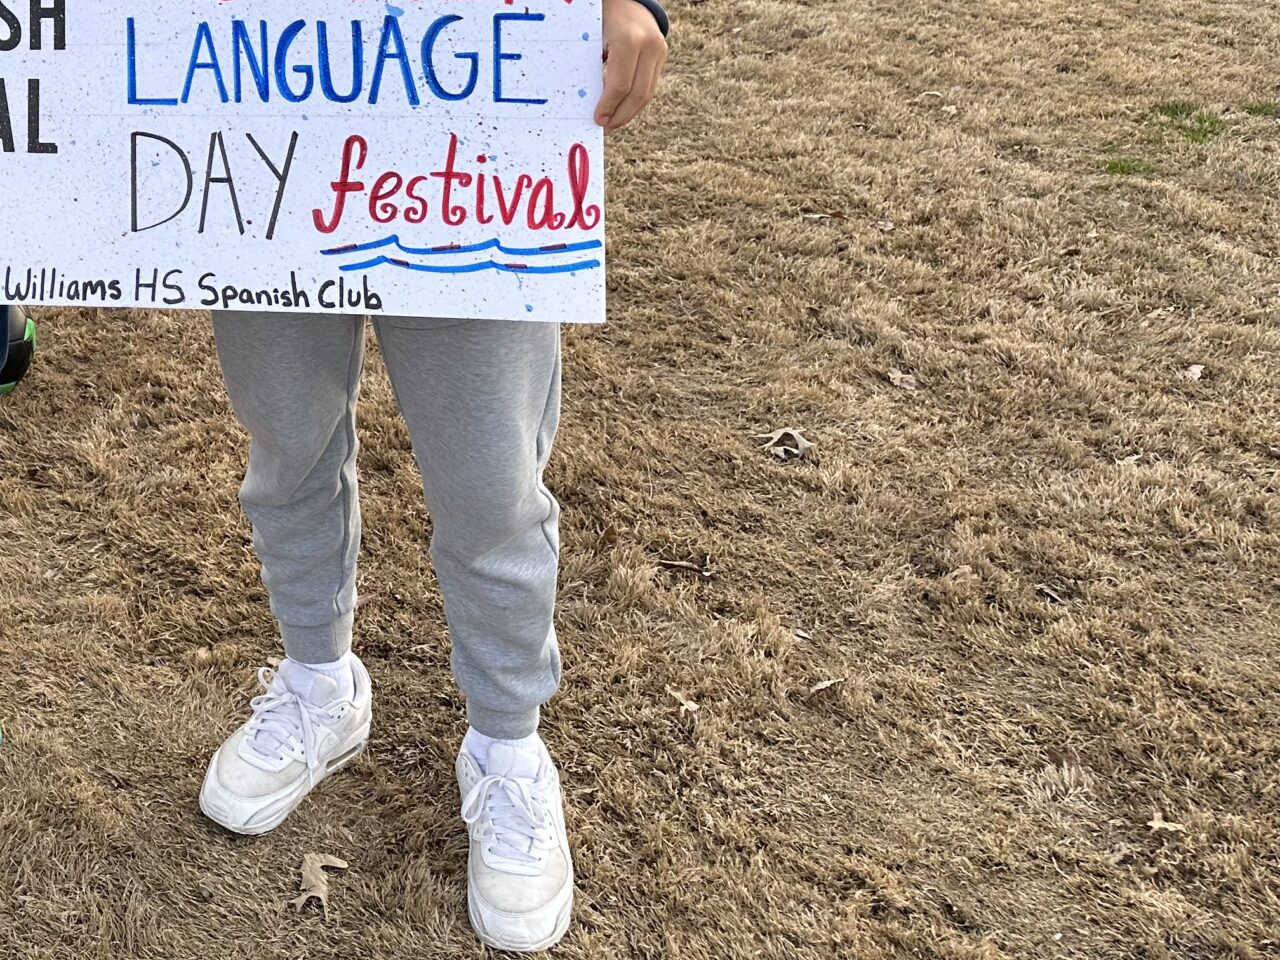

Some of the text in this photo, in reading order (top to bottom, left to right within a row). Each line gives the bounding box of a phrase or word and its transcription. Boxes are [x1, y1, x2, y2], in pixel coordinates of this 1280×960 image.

[126, 12, 548, 106] LANGUAGE
[130, 130, 601, 240] DAY festival
[134, 267, 185, 305] HS
[197, 271, 311, 310] Spanish
[317, 274, 383, 310] Club
